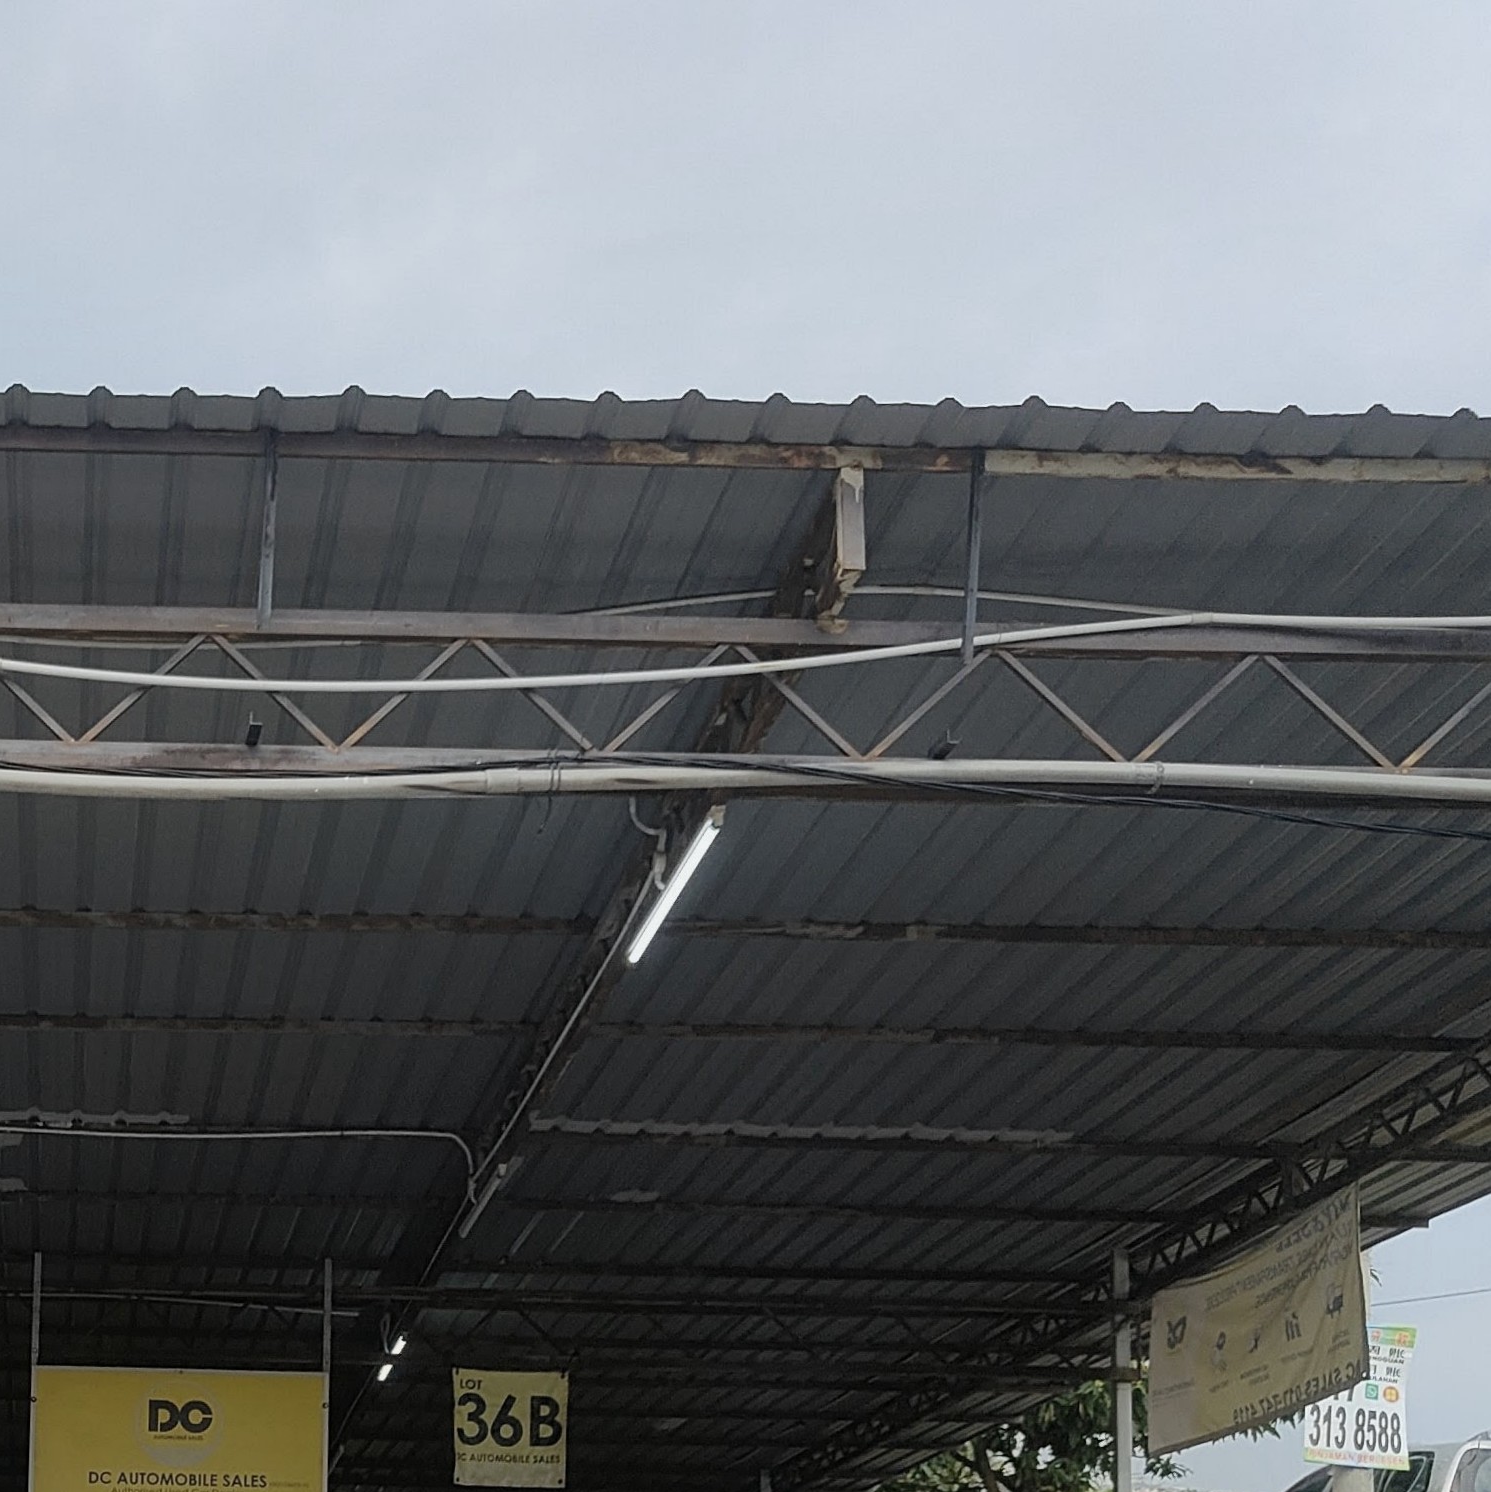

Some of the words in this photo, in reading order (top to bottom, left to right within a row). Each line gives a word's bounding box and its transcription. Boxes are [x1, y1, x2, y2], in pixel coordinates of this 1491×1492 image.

[459, 1379, 483, 1390] LOT
[148, 1399, 213, 1434] DC
[457, 1393, 562, 1447] 36B
[1308, 1404, 1347, 1449] 313
[1353, 1408, 1402, 1455] 8588
[470, 1453, 530, 1464] AUTOMOBILE
[532, 1454, 561, 1464] SALES
[88, 1471, 112, 1484] DC
[117, 1472, 218, 1487] AUTOMOBILE
[222, 1474, 267, 1488] SALES
